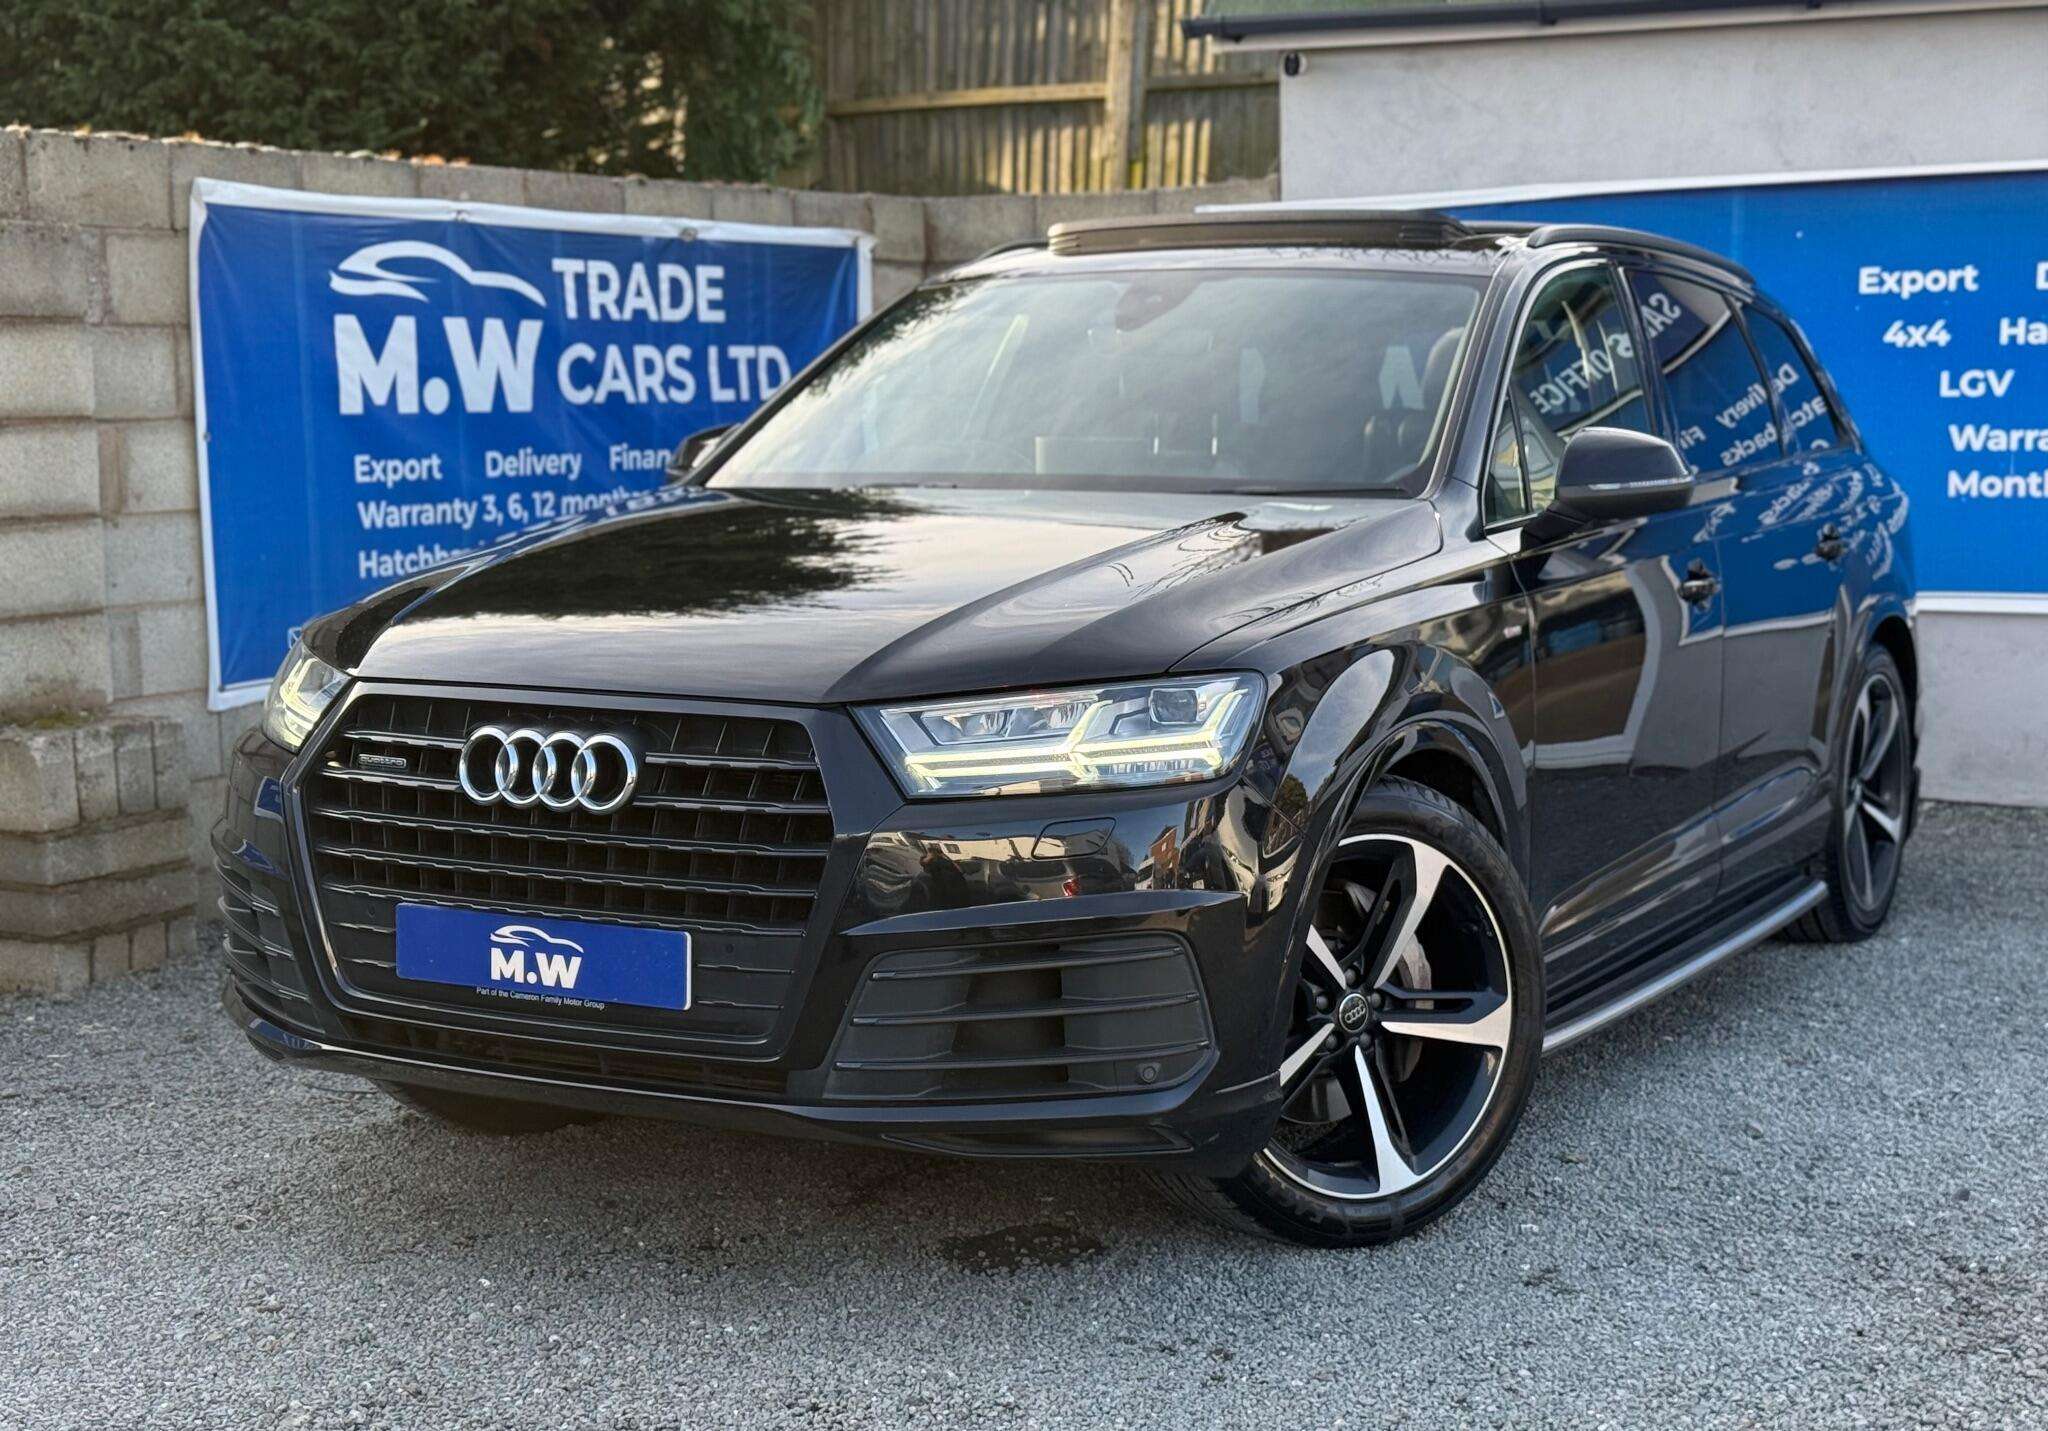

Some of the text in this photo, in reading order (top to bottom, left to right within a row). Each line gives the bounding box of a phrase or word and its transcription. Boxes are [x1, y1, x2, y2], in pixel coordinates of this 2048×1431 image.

[551, 257, 727, 324] TRADE
[1857, 264, 1980, 300] Export
[1882, 319, 1952, 348] 4x4
[333, 313, 544, 415] M.W
[557, 342, 792, 404] CARS LTD
[1938, 369, 2015, 399] LGV
[354, 453, 443, 488] Export
[484, 447, 583, 481] Delivery
[1947, 469, 2048, 498] Mont
[356, 499, 478, 531] Warranty
[481, 493, 504, 525] 3,
[507, 492, 530, 524] 6,
[532, 490, 556, 518] 12
[490, 947, 583, 990] M.W
[476, 986, 606, 1011] Part of the Cameron Family Motor Group
